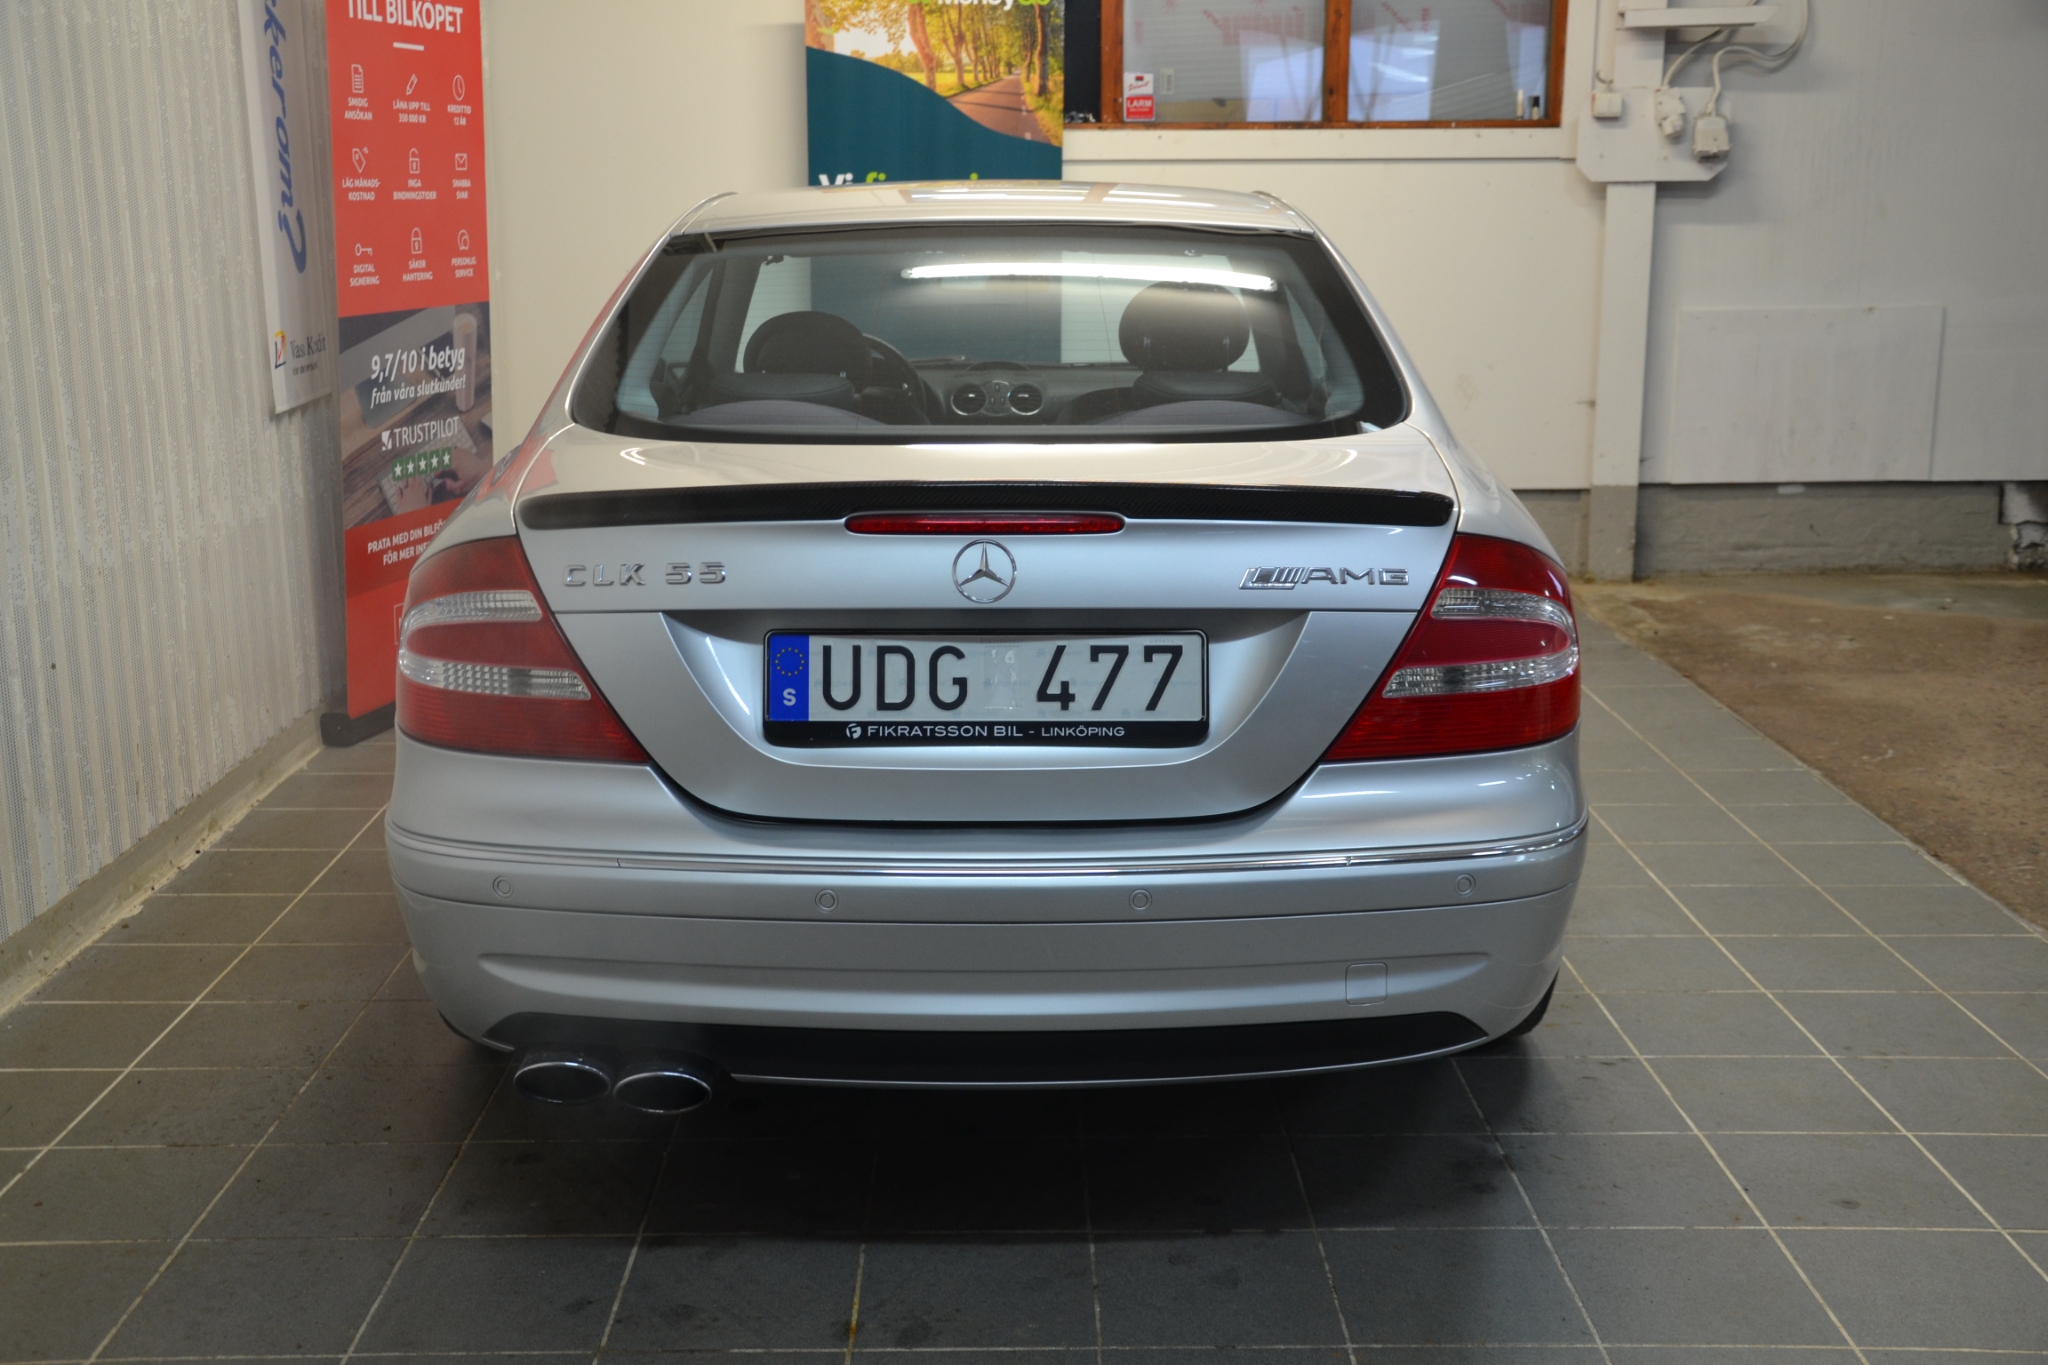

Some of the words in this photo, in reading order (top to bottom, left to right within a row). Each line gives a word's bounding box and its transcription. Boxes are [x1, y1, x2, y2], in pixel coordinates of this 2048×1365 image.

[385, 0, 463, 34] BILKÖPET
[348, 97, 369, 107] SMIDIG
[393, 99, 408, 110] LÅNA
[408, 100, 420, 111] UPP
[420, 102, 431, 112] TILL
[1127, 99, 1152, 107] LARM
[344, 109, 373, 121] ANSÖKAN
[419, 115, 427, 124] KR
[342, 177, 354, 188] LÅG
[408, 179, 422, 188] INGA
[452, 179, 471, 188] SNABBA
[348, 191, 375, 201] KOSTNAD
[393, 191, 437, 201] BINDNINGSTIDER
[456, 191, 468, 200] SVAR
[408, 258, 426, 269] SÄKER
[451, 256, 476, 266] PERSONLIG
[353, 263, 375, 274] DIGITAL
[455, 268, 474, 278] SERVICE
[349, 276, 379, 287] SIGNERING
[402, 271, 433, 282] HANTERING
[371, 349, 418, 383] 9,7/10
[420, 346, 426, 372] i
[428, 345, 466, 373] betyg
[370, 385, 392, 409] från
[393, 382, 415, 401] våra
[417, 374, 466, 397] slutkunder!
[393, 416, 460, 448] TRUSTPILOT
[367, 537, 391, 554] PRATA
[392, 531, 409, 547] MED
[410, 527, 423, 541] DIN
[424, 518, 446, 537] BILFÖ
[383, 550, 398, 566] FÖR
[399, 546, 415, 561] MER
[563, 563, 646, 587] CLK
[665, 562, 727, 585] 55
[1301, 567, 1409, 586] AMG
[822, 644, 968, 711] UDG
[1036, 644, 1184, 712] 477
[782, 688, 797, 706] S
[867, 725, 988, 737] FIKRATSSON
[994, 725, 1024, 737] BIL
[1041, 724, 1126, 737] LINKÖPING
